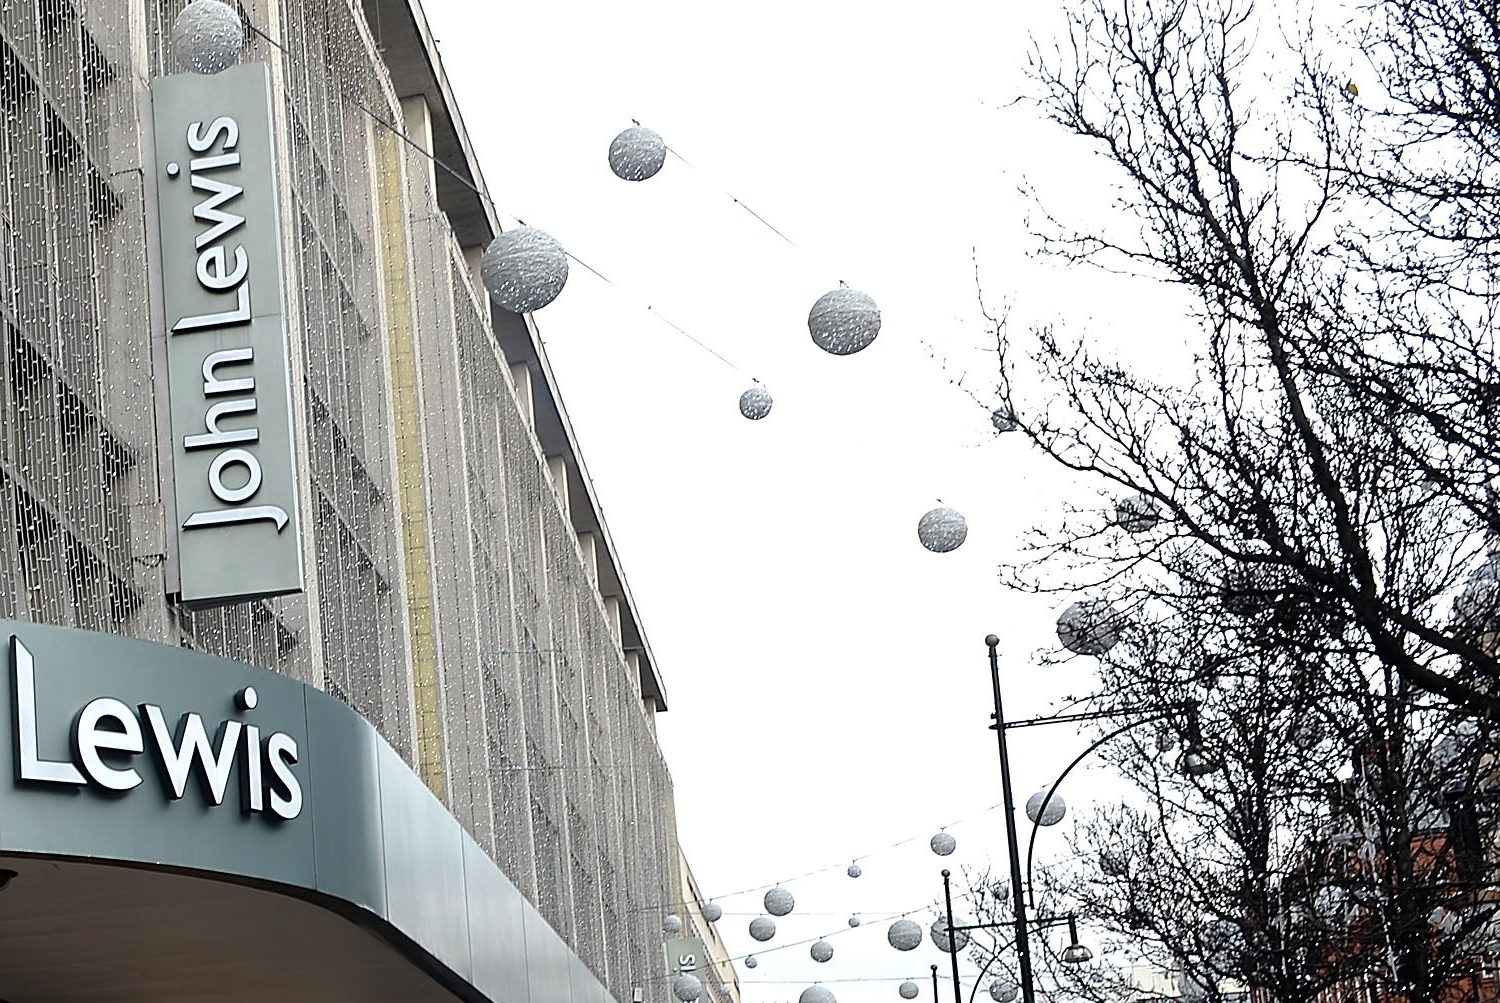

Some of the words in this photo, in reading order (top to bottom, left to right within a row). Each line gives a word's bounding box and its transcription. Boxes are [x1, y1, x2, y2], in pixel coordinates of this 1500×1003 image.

[166, 114, 252, 335] Lewis
[181, 346, 290, 534] John
[10, 633, 304, 823] Lewis
